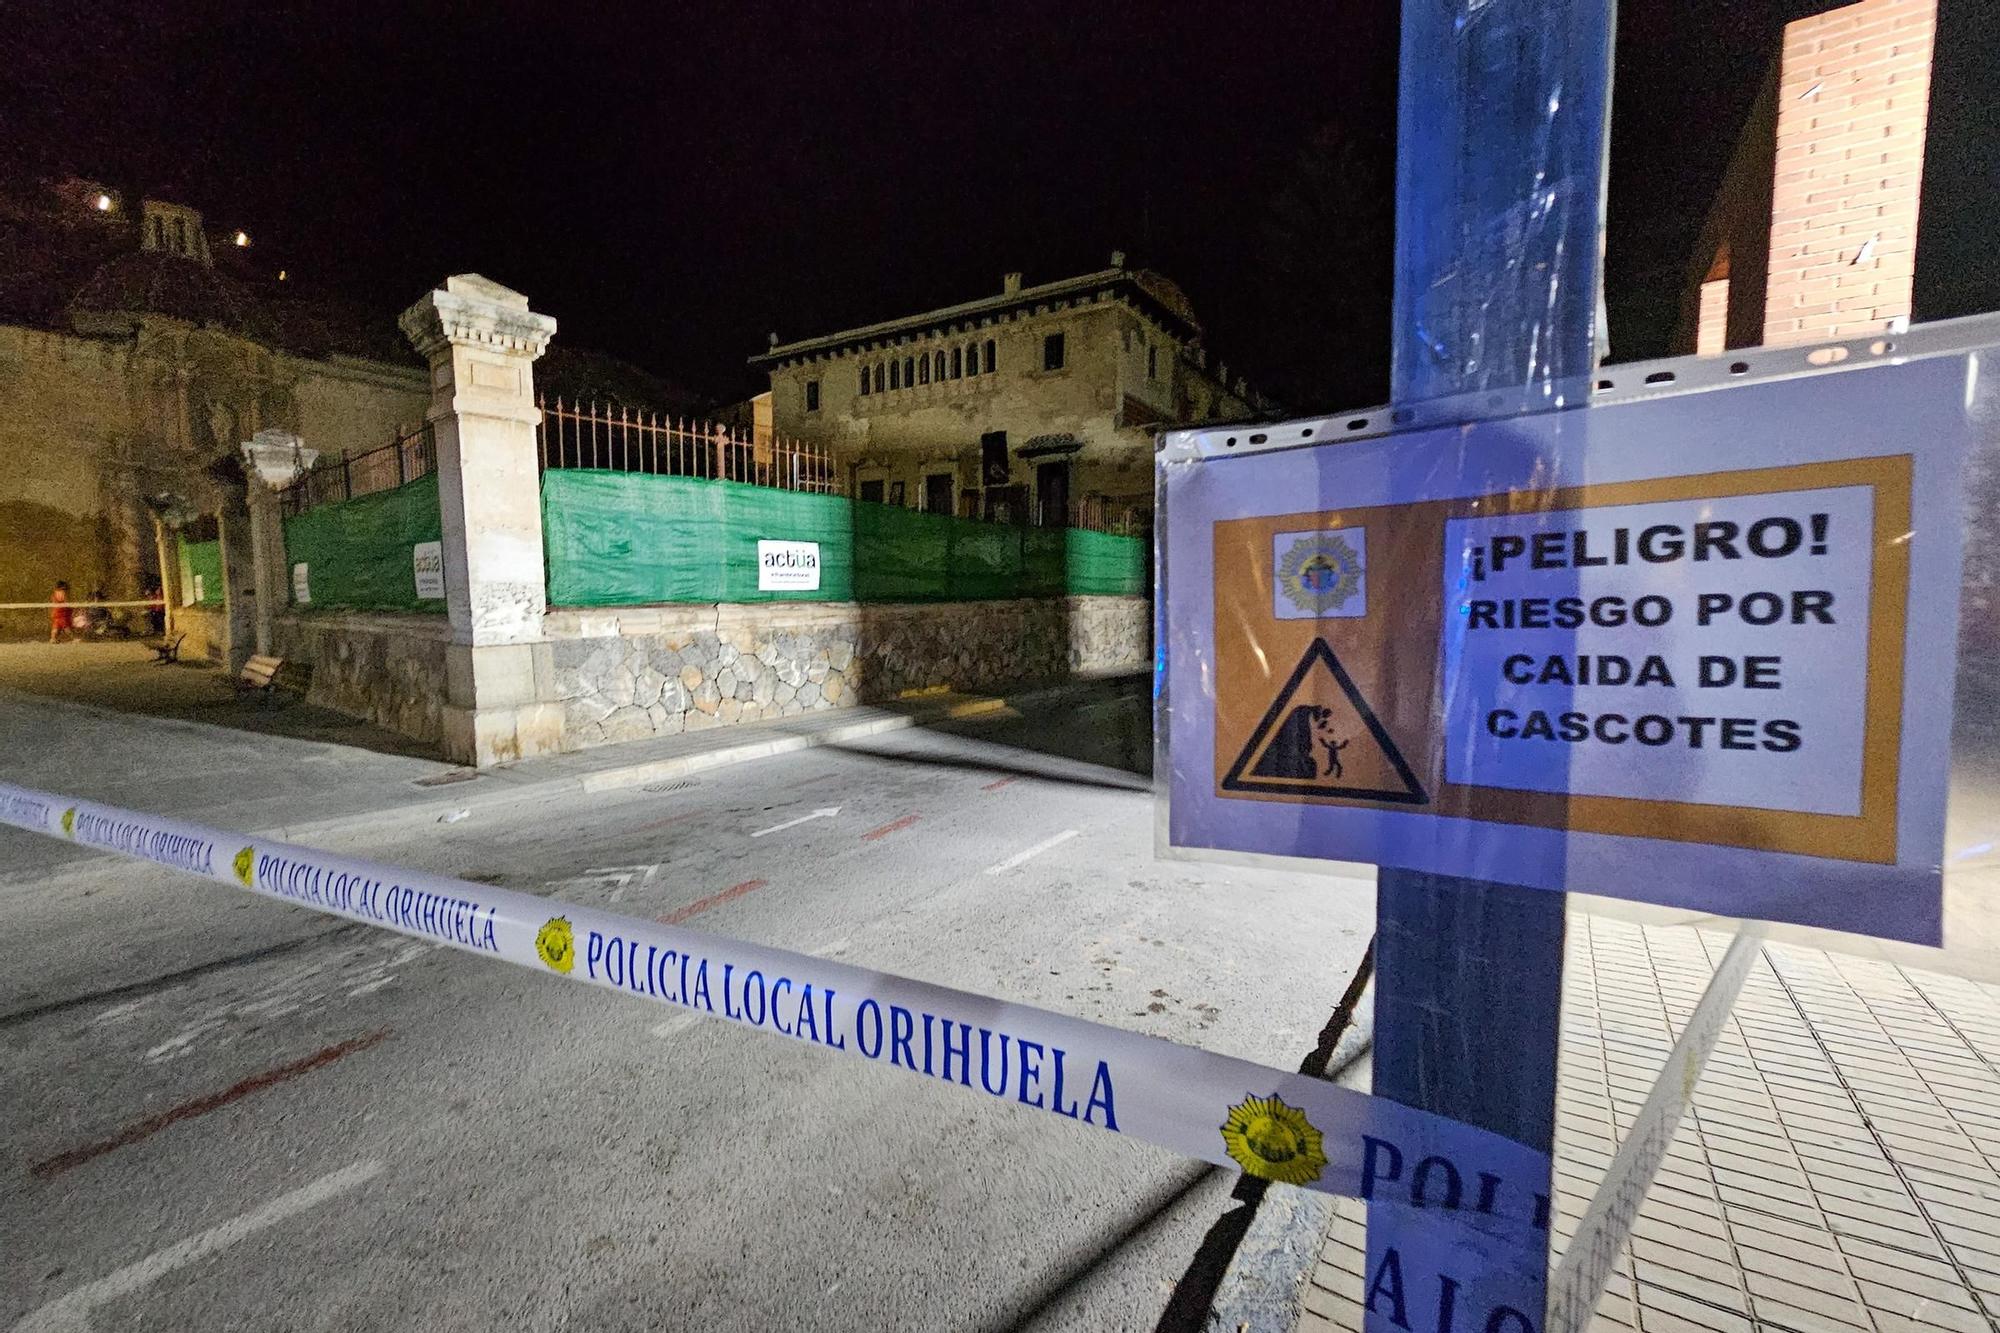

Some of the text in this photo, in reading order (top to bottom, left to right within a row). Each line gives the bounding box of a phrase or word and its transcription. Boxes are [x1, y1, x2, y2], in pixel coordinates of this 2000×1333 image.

[1472, 513, 1829, 582] ¡PELIGRO!
[1468, 590, 1836, 629] RIESGO POR
[1502, 653, 1782, 691] CAIDA DE
[1487, 708, 1802, 753] CASCOTES
[258, 854, 500, 952] POLICIA LOCAL ORIHUELA
[587, 931, 1121, 1132] POLICIA LOCAL ORIHUELA
